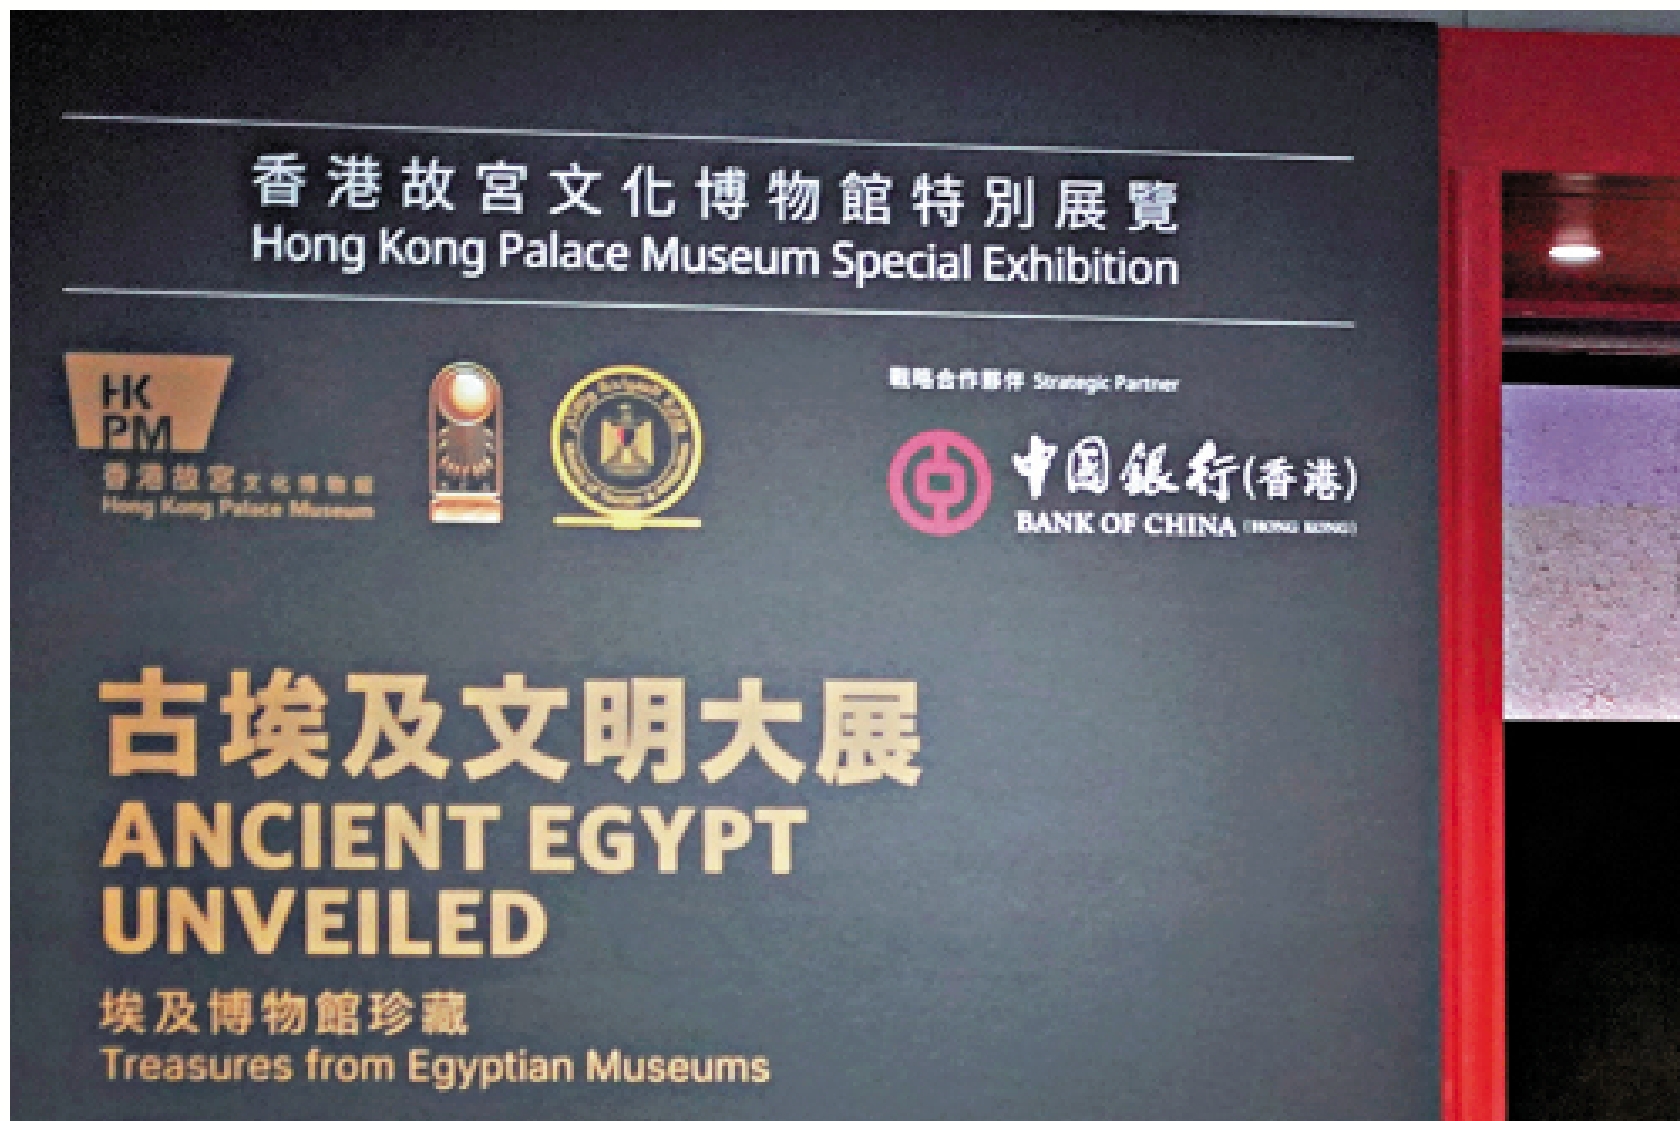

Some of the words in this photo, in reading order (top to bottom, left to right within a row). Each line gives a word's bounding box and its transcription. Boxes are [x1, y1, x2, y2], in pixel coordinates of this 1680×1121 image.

[252, 152, 1180, 232] 香港故宮文化博物館特別展覽
[253, 223, 366, 275] Hong
[378, 226, 487, 279] Kong
[499, 229, 631, 272] Palace
[643, 236, 820, 275] Museum
[832, 239, 972, 289] Special
[983, 244, 1180, 285] Exhibition
[102, 372, 153, 411] HK
[1033, 371, 1113, 396] Strategic
[1114, 374, 1180, 393] Partner
[102, 415, 174, 452] PM
[1017, 509, 1096, 534] BANK
[1101, 512, 1136, 534] OF
[1144, 512, 1237, 538] CHINA
[98, 664, 925, 787] 古埃及文明大展
[102, 801, 501, 871] ANCIENT
[529, 805, 807, 875] EGYPT
[102, 886, 548, 959] UNVEILED
[99, 987, 470, 1036] 埃及博物館珍藏
[101, 1048, 294, 1083] Treasures
[304, 1049, 396, 1083] from
[408, 1049, 575, 1090] Egyptian
[586, 1050, 770, 1083] Museums
